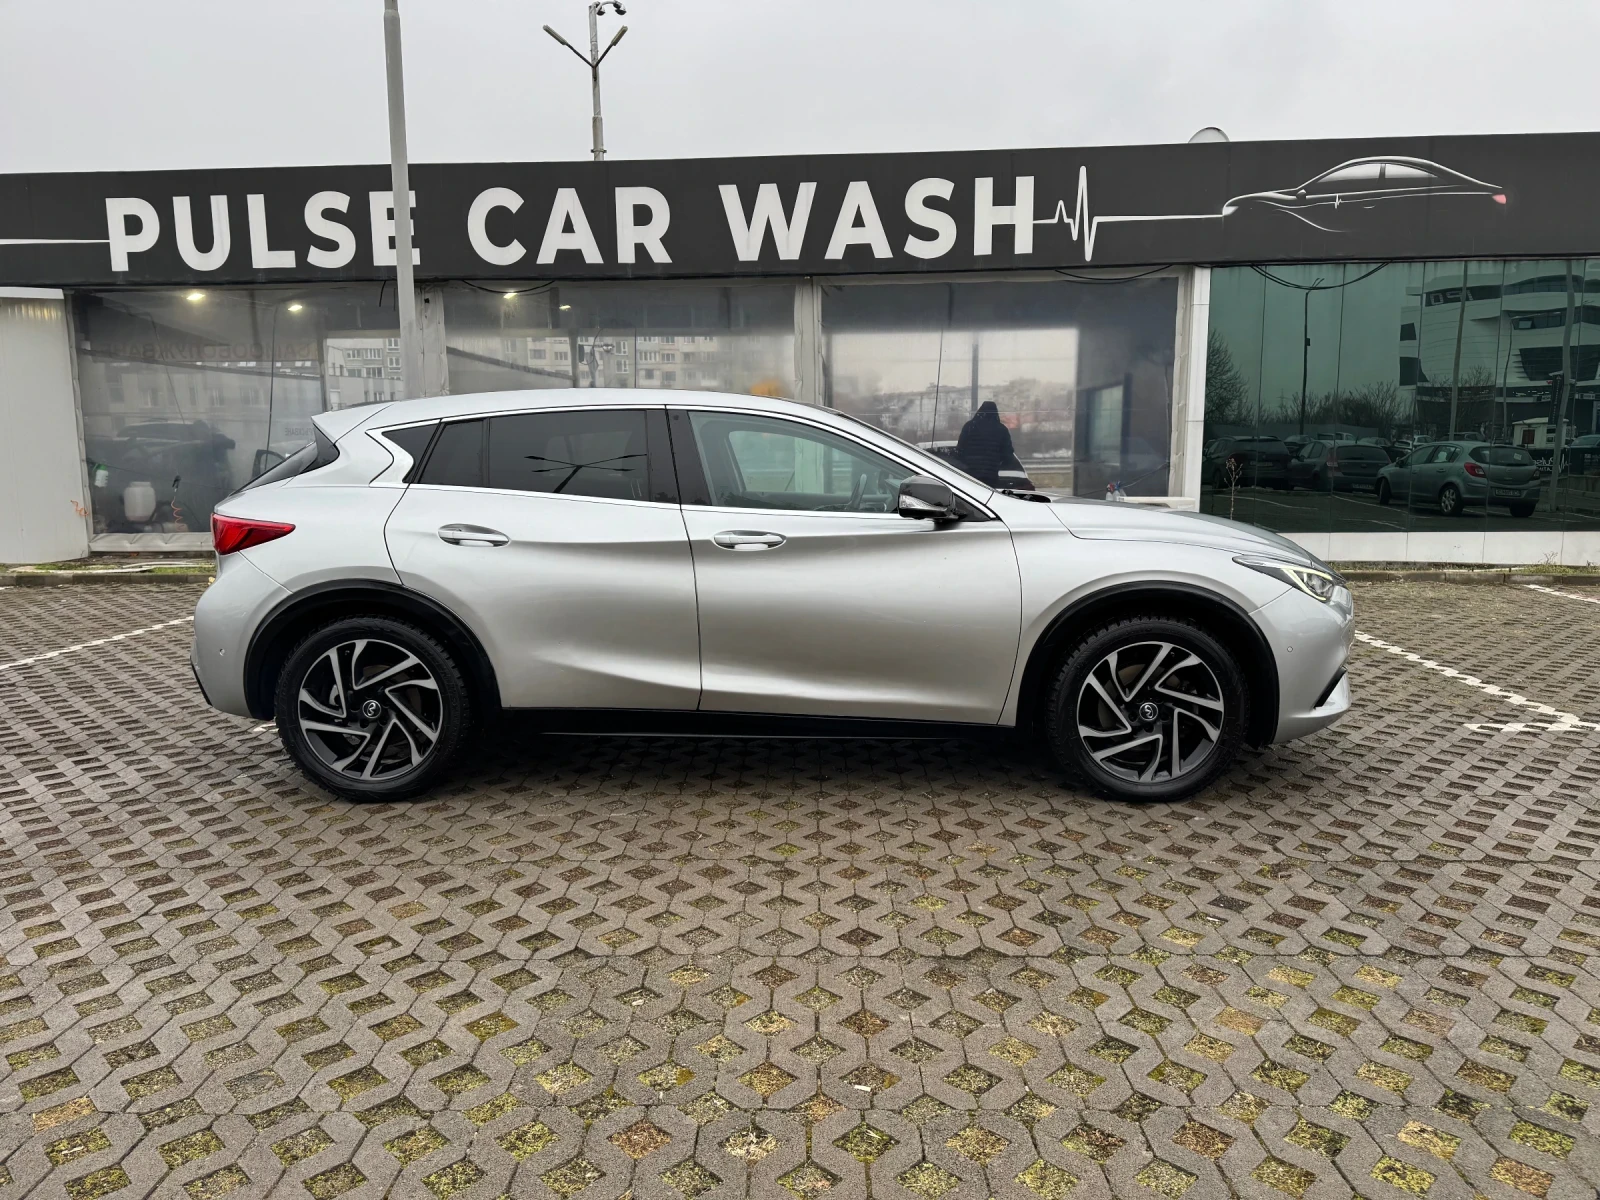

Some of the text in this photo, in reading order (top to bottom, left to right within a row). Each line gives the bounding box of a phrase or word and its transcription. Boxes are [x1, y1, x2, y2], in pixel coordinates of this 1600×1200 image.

[105, 176, 1034, 272] PULSE CAR WASH
